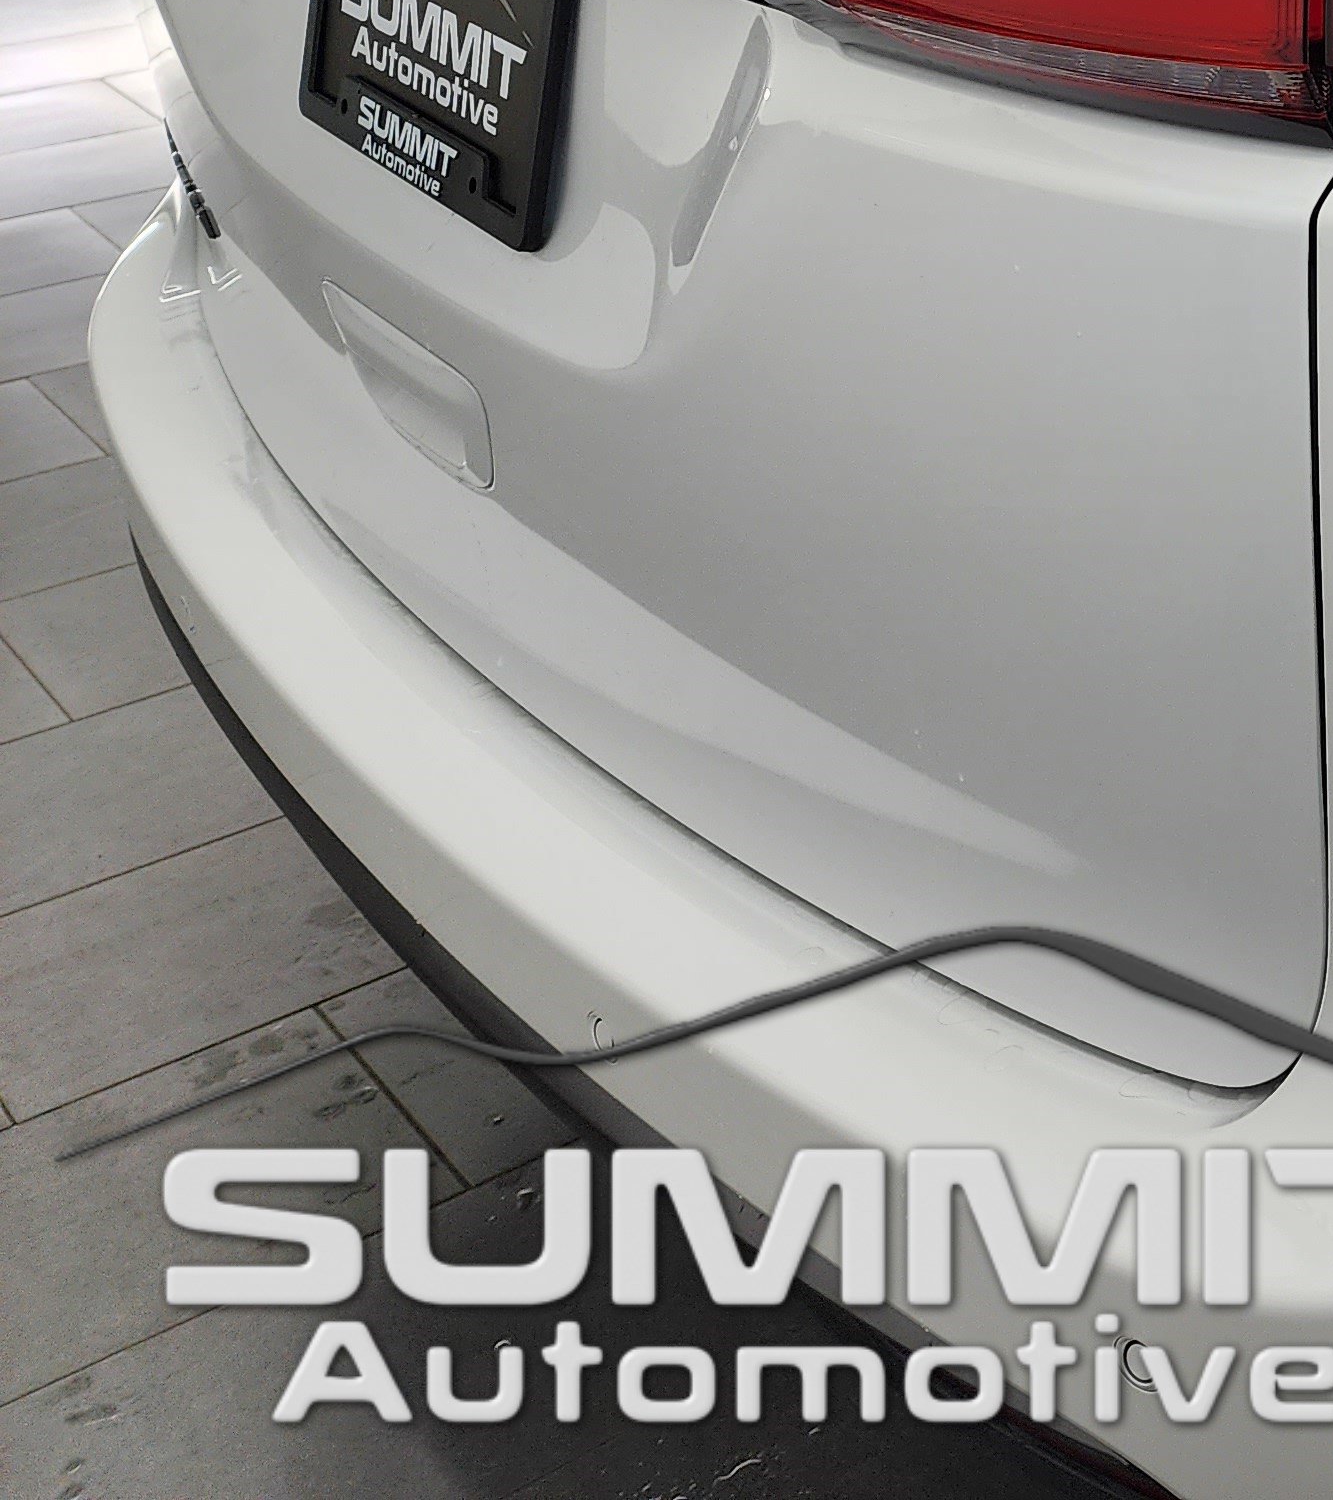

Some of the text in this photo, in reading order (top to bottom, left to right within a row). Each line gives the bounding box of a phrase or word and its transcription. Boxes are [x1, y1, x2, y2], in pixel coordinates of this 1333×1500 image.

[351, 25, 499, 136] Automotive
[357, 95, 458, 178] SUMMIT
[361, 133, 442, 197] Automotive
